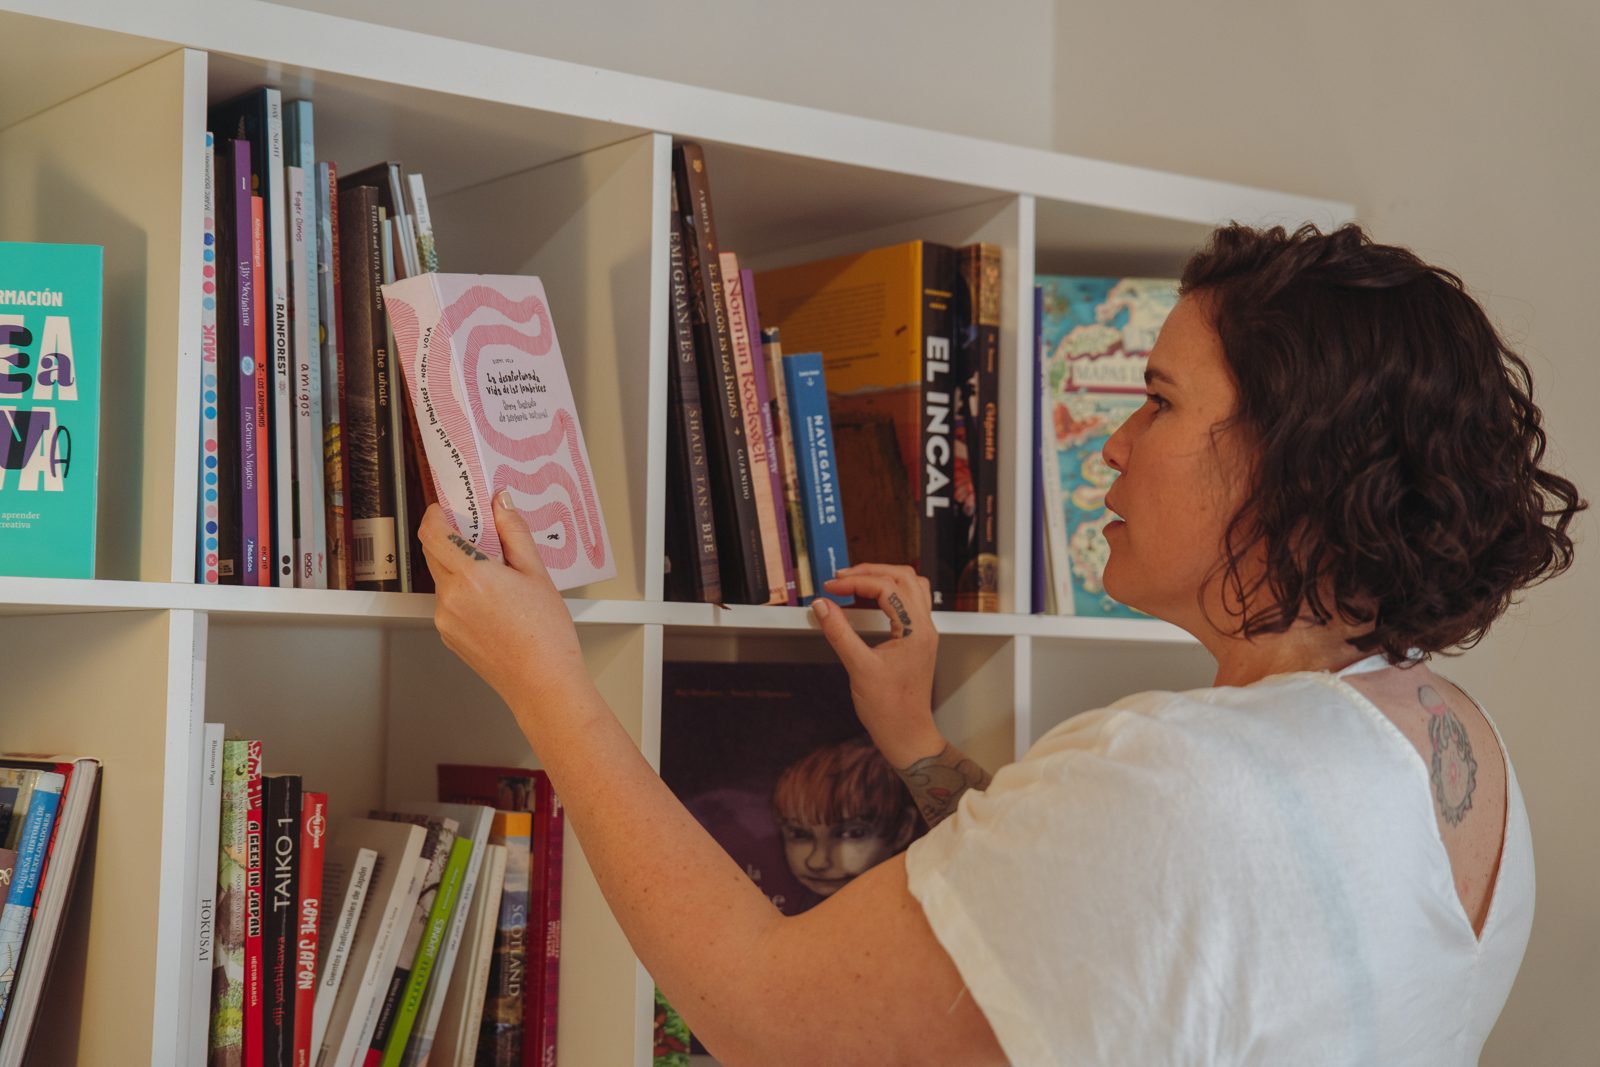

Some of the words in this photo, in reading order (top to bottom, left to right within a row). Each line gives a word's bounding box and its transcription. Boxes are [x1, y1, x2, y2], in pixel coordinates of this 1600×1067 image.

[370, 205, 380, 233] ETHAN
[372, 235, 380, 249] and
[240, 261, 250, 279] Lily
[294, 191, 304, 214] Roger
[300, 363, 310, 417] amigos
[670, 231, 692, 363] EMIGRANTES
[202, 324, 217, 363] MUK
[276, 303, 287, 376] RAINFOREST
[422, 326, 432, 348] VOLA
[376, 349, 386, 369] the
[420, 353, 428, 378] NOEMI
[727, 278, 748, 366] Norman
[740, 372, 766, 464] Rockwell
[926, 335, 950, 383] EL
[378, 371, 388, 407] whale
[420, 388, 438, 426] lombrices
[244, 406, 254, 422] Las
[258, 390, 266, 428] CARPINCHOS
[245, 422, 254, 451] Gemas
[436, 428, 446, 440] las
[444, 438, 452, 448] de
[450, 448, 462, 470] vida
[814, 415, 837, 524] NAVEGANTES
[926, 390, 950, 518] INCAL
[688, 410, 702, 465] SHAUN
[696, 477, 708, 506] TAN
[702, 523, 714, 552] BFE
[736, 449, 750, 500] GUARNIDO
[459, 471, 478, 532] desafortunada
[468, 532, 478, 544] La
[248, 820, 260, 831] A
[277, 818, 293, 828] 1
[248, 834, 260, 868] GEEK
[248, 872, 260, 887] IN
[274, 835, 292, 912] TAIKO
[198, 899, 212, 961] HOKUSAI
[248, 890, 261, 938] JAPAN
[301, 899, 318, 935] COME
[326, 954, 342, 987] Cuentos
[336, 900, 358, 954] tradicionales
[352, 888, 360, 900] de
[356, 865, 368, 889] Japón
[274, 936, 286, 1002] yoshikawa
[298, 938, 316, 990] JAPÓN
[509, 904, 523, 996] SCOTLAND
